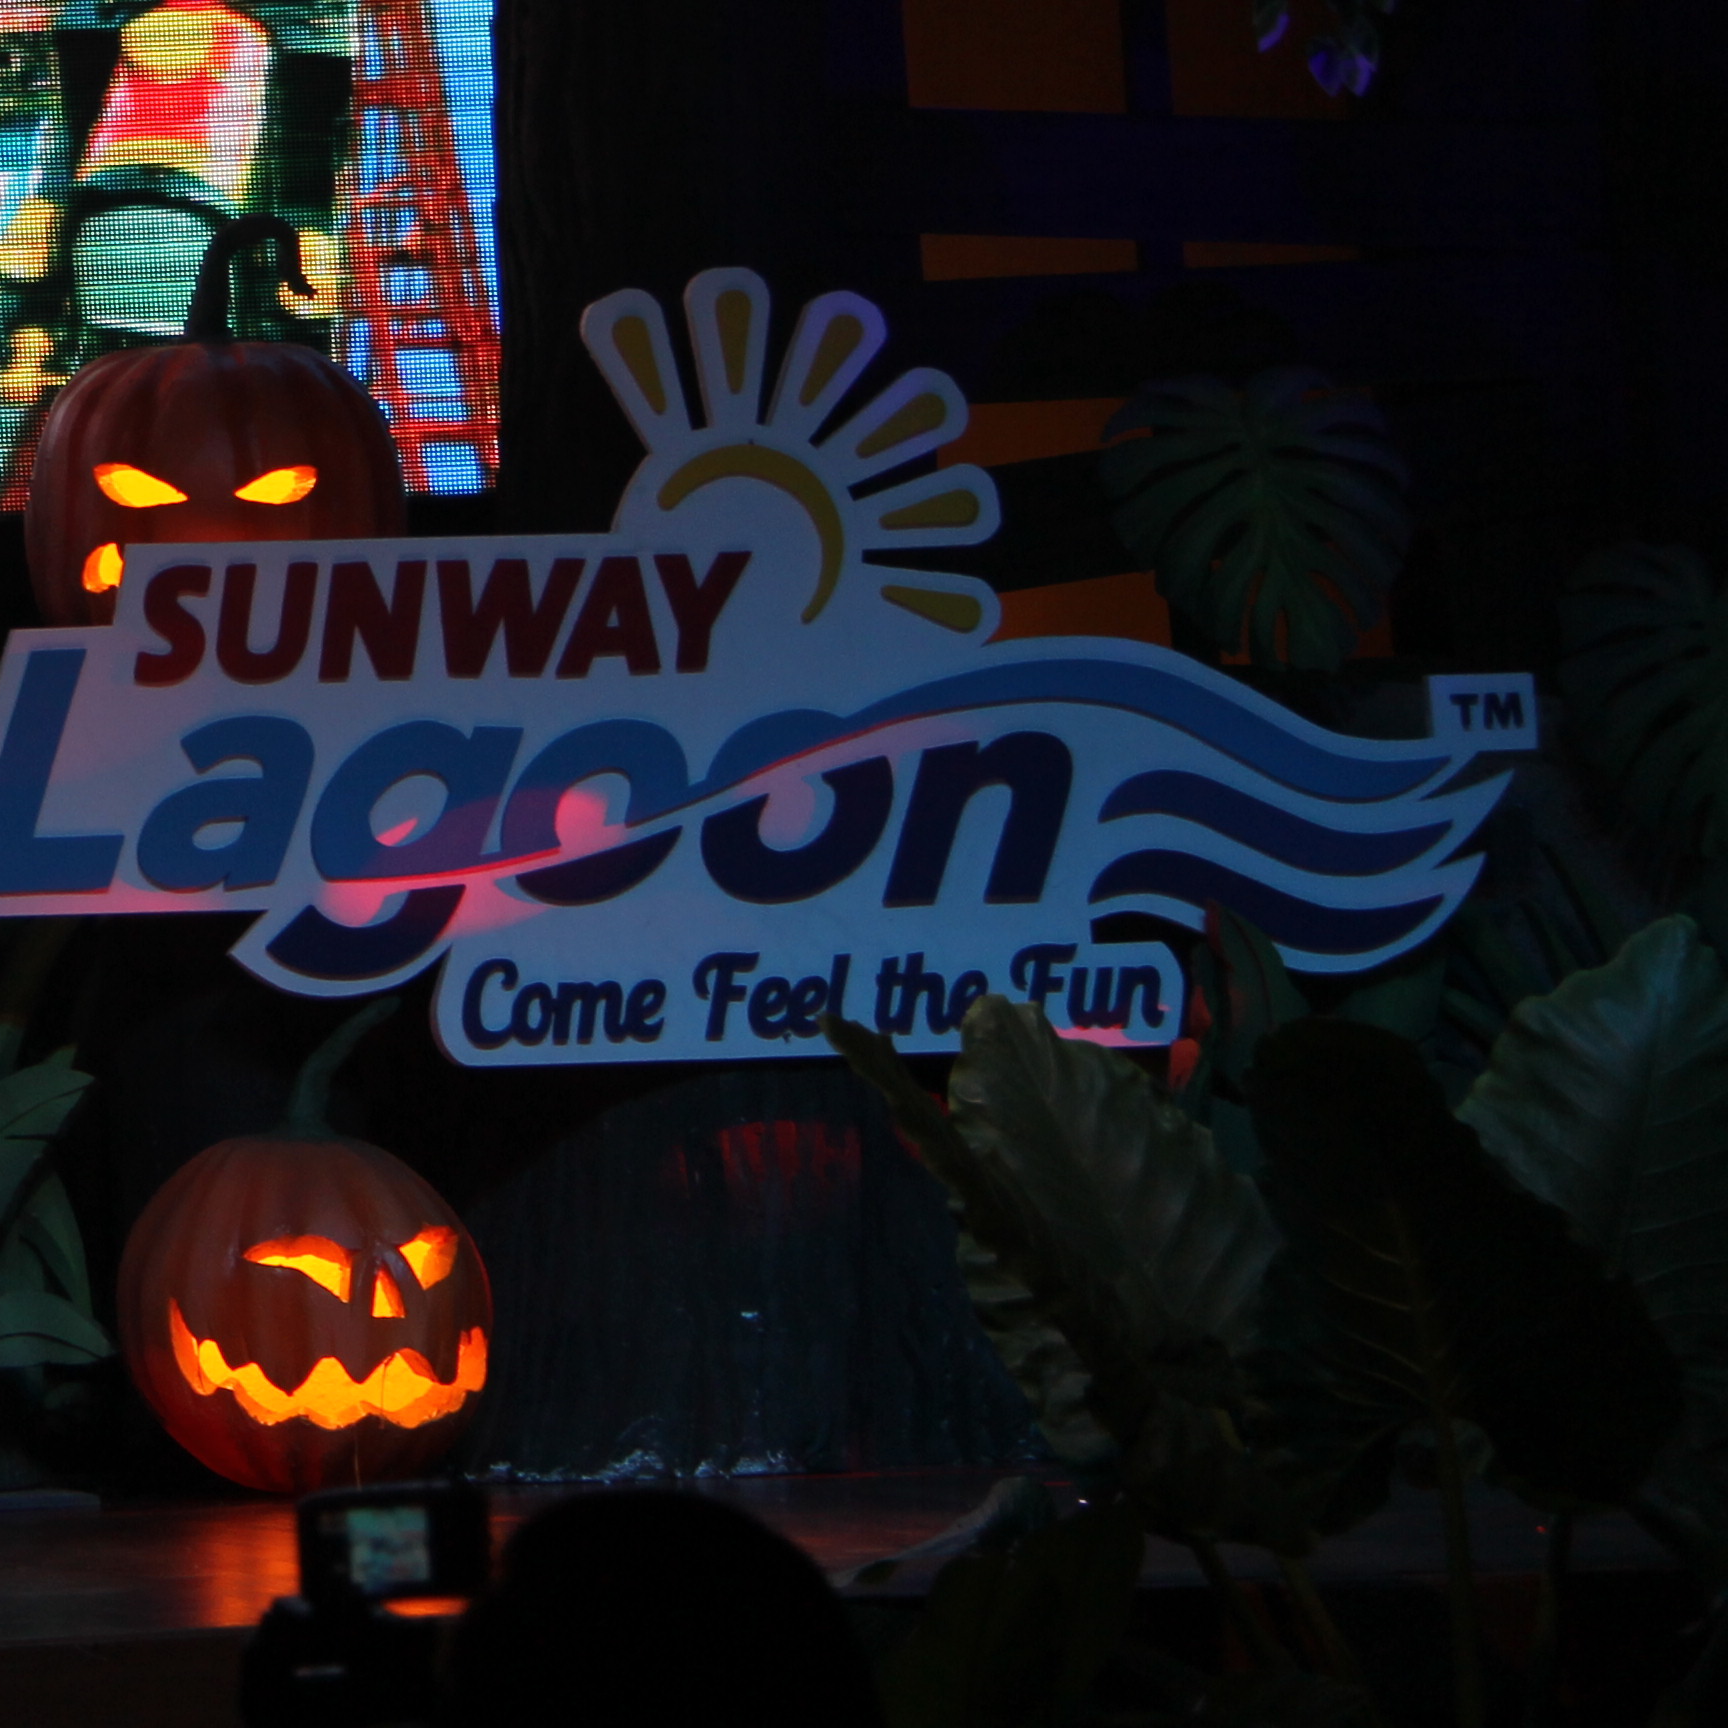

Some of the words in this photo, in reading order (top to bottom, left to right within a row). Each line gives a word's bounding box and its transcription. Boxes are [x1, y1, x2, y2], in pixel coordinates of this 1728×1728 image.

[133, 549, 752, 685] SUNWAY
[1448, 688, 1525, 729] TM
[460, 957, 666, 1050] Come
[692, 951, 852, 1042] Feel
[873, 951, 990, 1036] the
